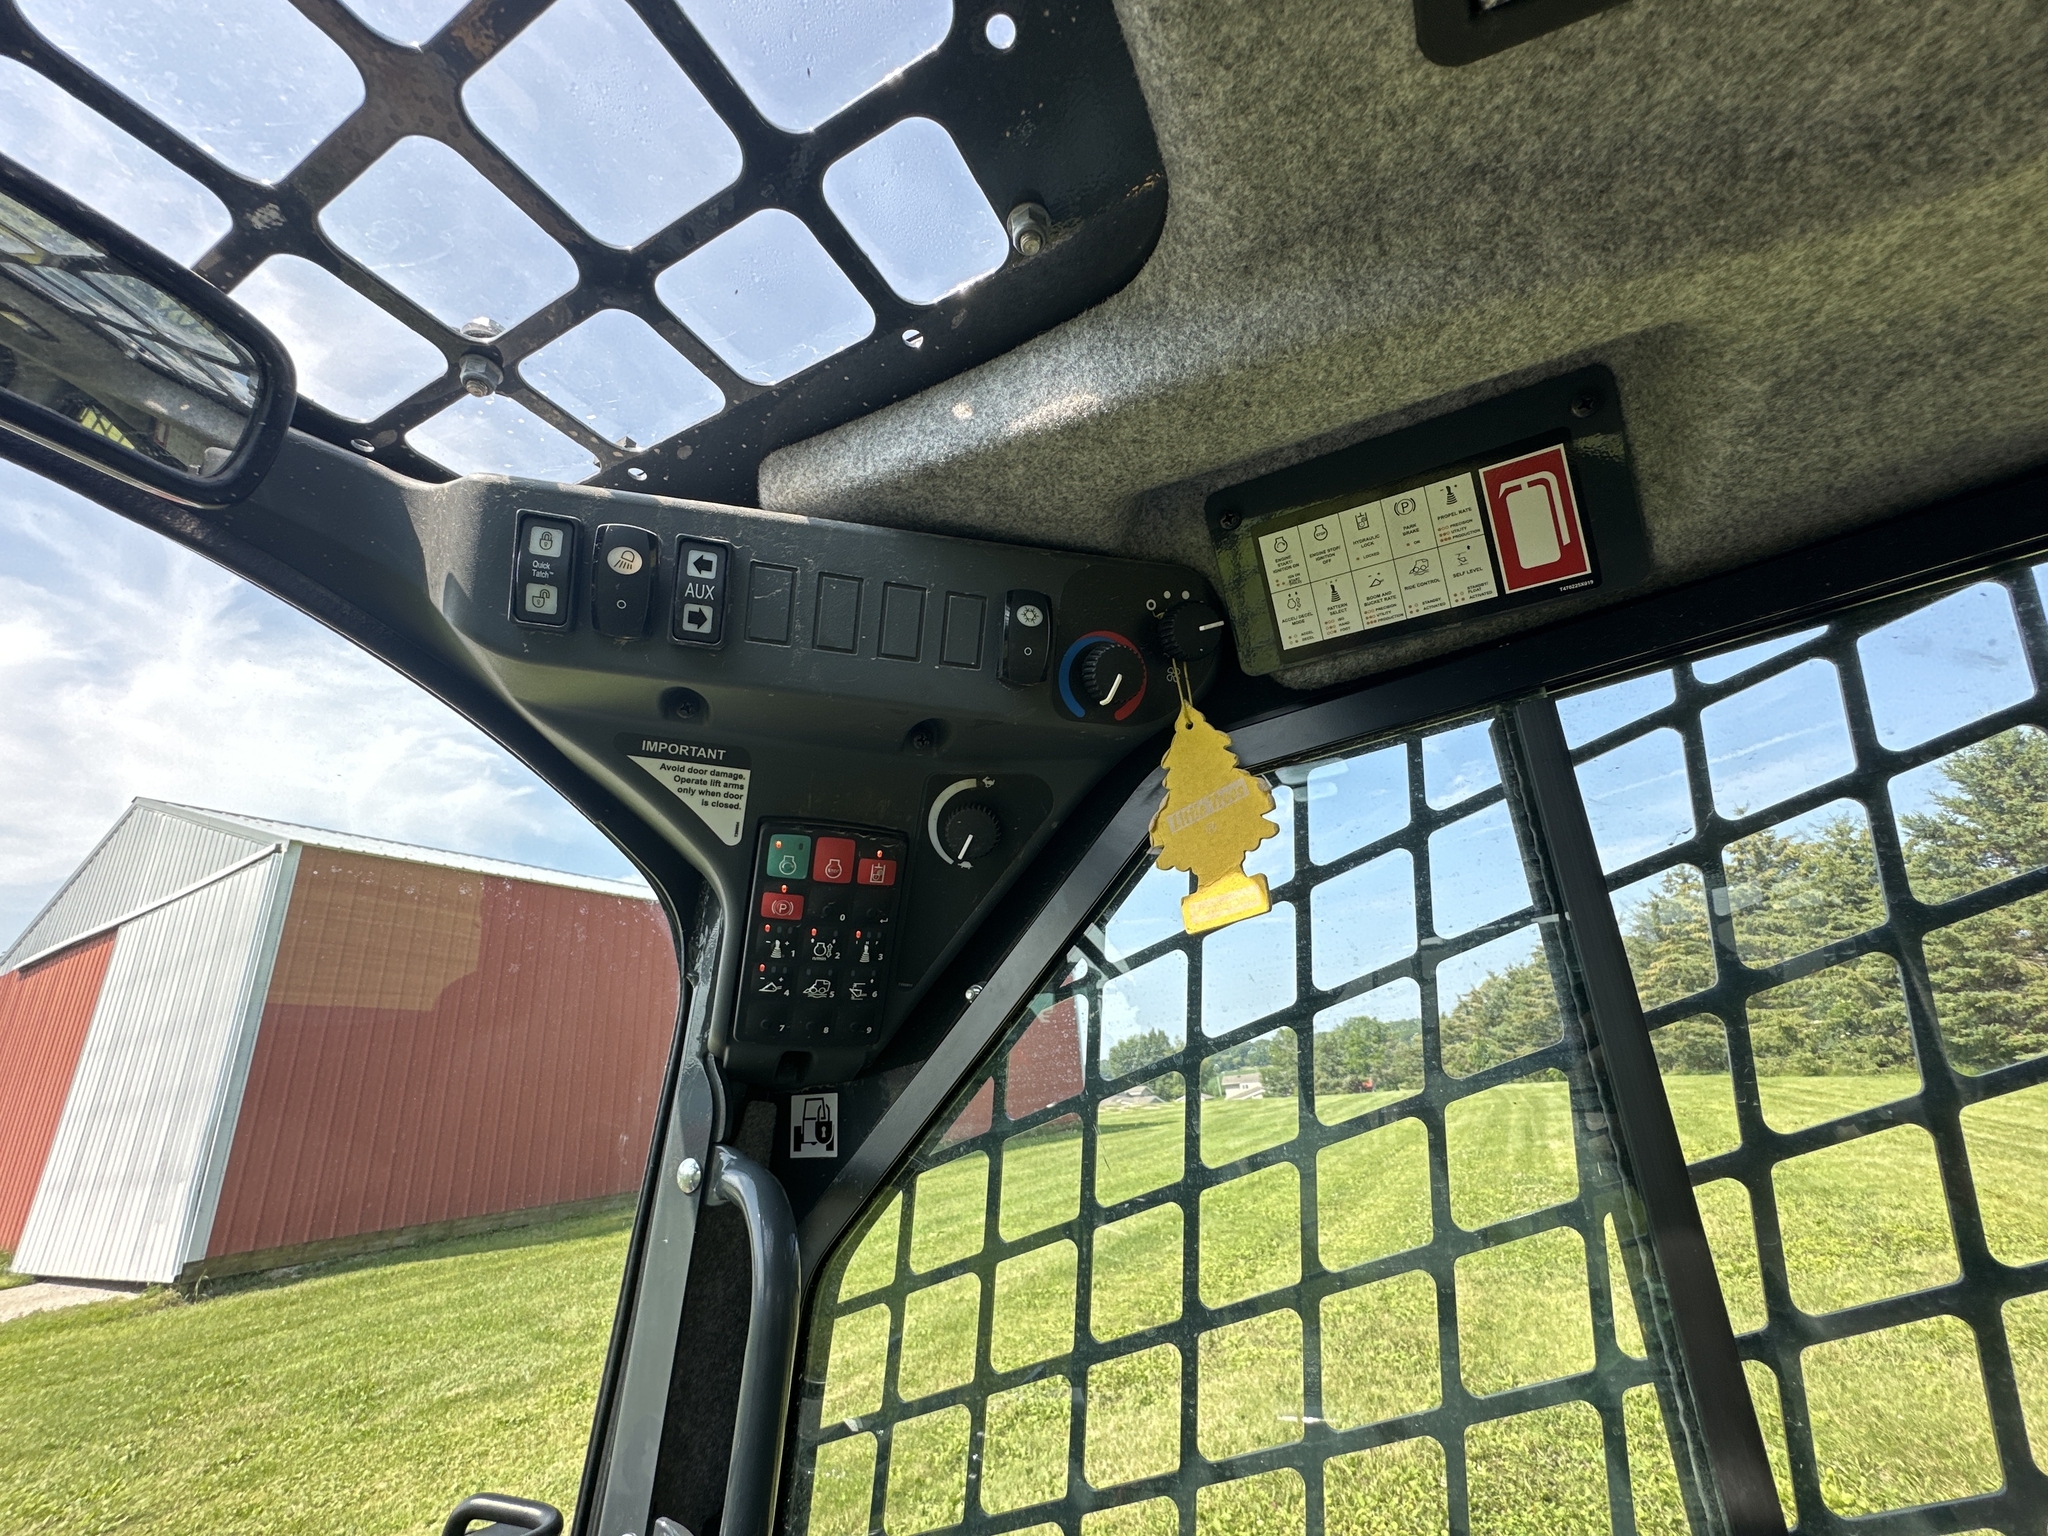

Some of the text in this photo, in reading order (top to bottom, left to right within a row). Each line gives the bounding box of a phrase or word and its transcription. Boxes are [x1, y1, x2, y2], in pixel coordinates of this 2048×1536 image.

[1437, 512, 1458, 521] PROPEL
[1450, 519, 1473, 528] PRECISION
[1402, 528, 1419, 536] BRAKE
[1452, 529, 1480, 539] PRODUCTION
[1353, 534, 1380, 545] HYDRAULIC
[1275, 555, 1292, 563] ENGINE
[1315, 553, 1336, 561] IGNITION
[1273, 565, 1292, 574] IGNITION
[1418, 579, 1440, 587] CONTROL
[685, 583, 715, 600] AUX
[1469, 591, 1492, 599] ACTIVATED
[1327, 603, 1348, 611] PATTERN
[1364, 598, 1384, 607] BUCKET
[1423, 602, 1446, 610] ACTIVATED
[1375, 603, 1397, 612] PRECISION
[1378, 613, 1404, 623] PRODUCTION
[642, 740, 726, 760] IMPORTANT
[660, 763, 746, 780] Avoid door damage.
[674, 775, 707, 786] Operate
[710, 779, 721, 787] lift
[677, 786, 744, 800] only when door
[711, 800, 741, 810] closed.
